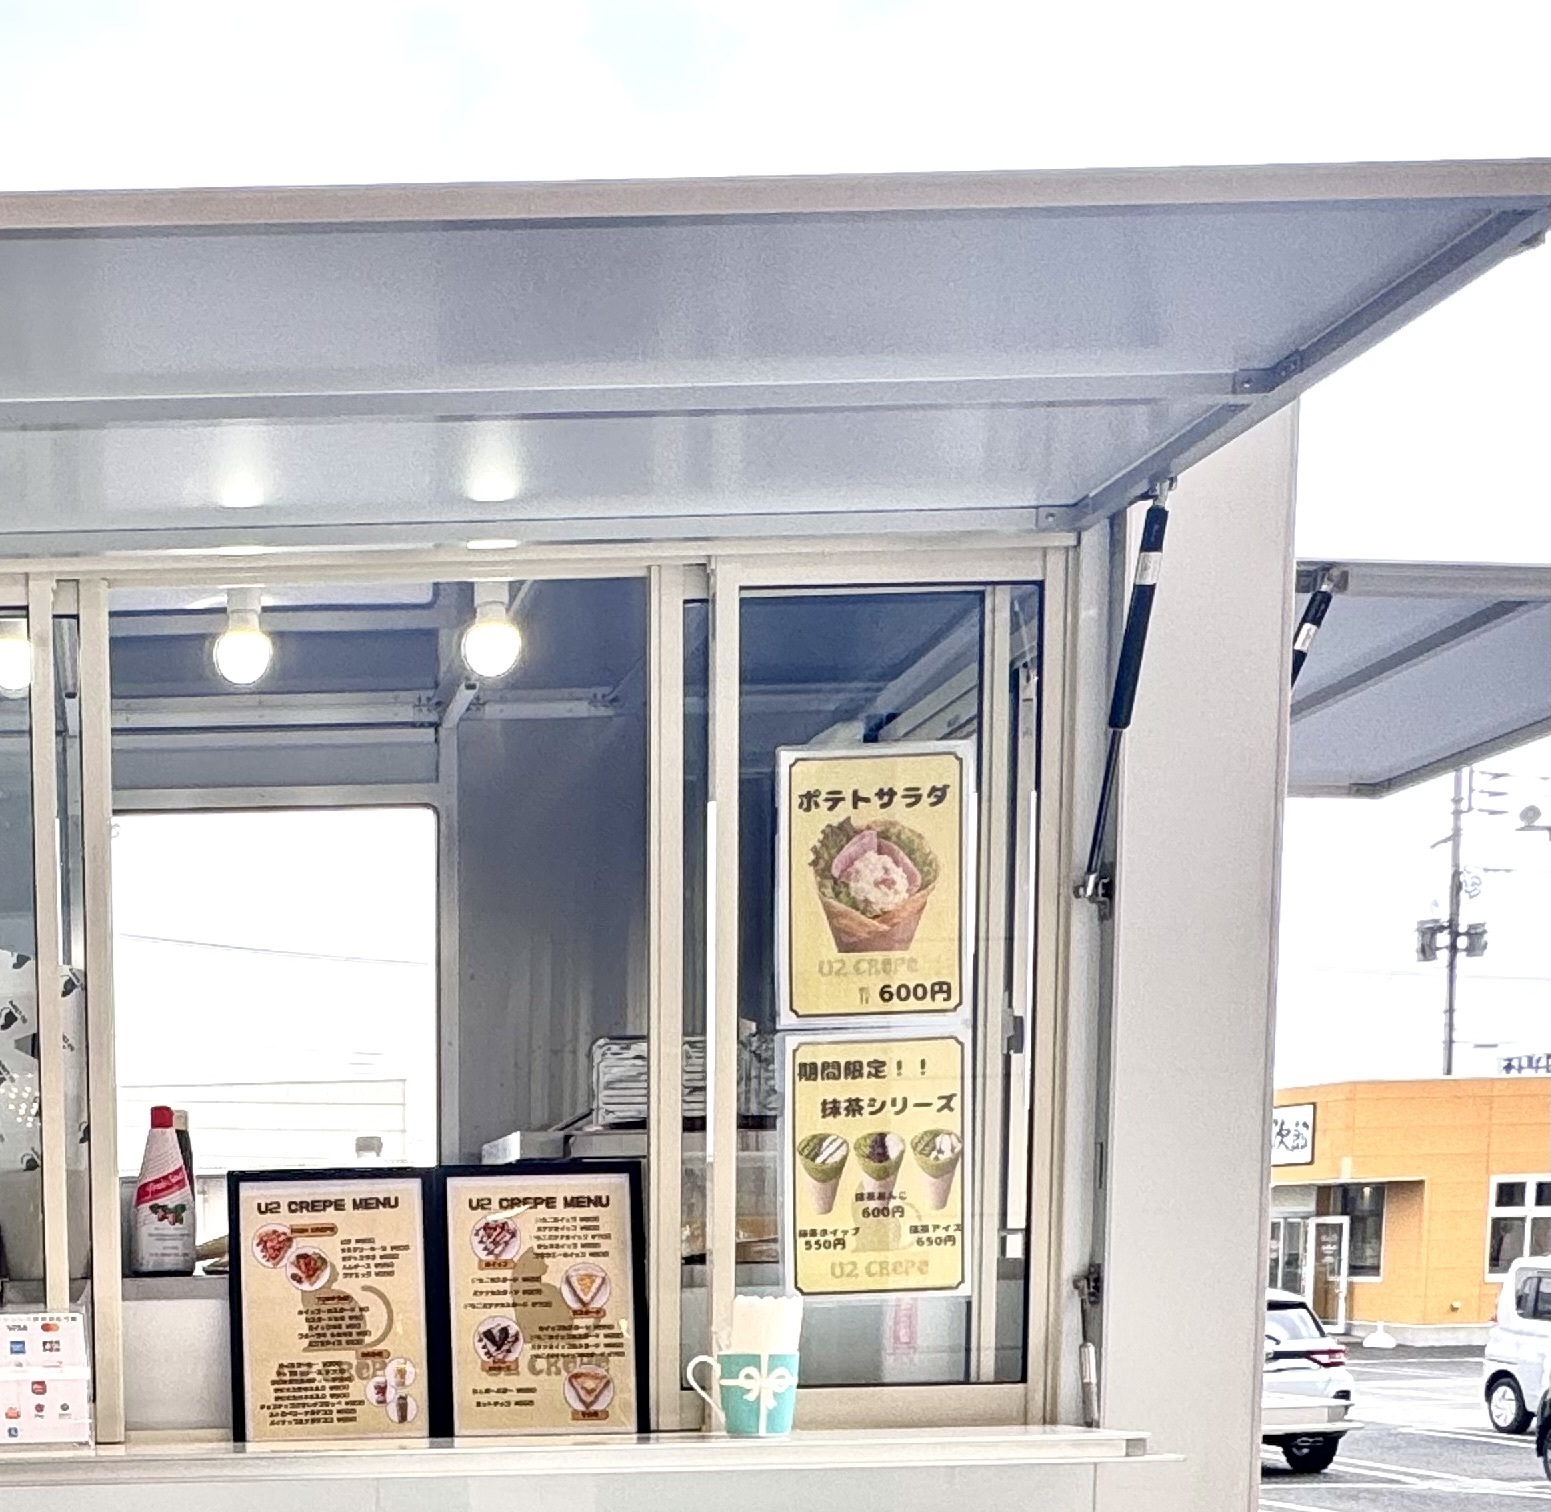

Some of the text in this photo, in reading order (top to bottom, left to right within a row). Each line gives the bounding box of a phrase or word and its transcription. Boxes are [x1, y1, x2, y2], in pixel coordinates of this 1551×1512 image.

[797, 784, 951, 812] ポテトサラダ
[878, 980, 952, 1004] 600円
[820, 1092, 958, 1119] 抹茶シリーズ
[257, 1196, 399, 1215] U2 CREPE MENU
[468, 1195, 611, 1211] U2 CREPE MENU
[861, 1205, 905, 1219] 600円
[804, 1237, 847, 1251] 550円
[916, 1234, 957, 1247] 650円
